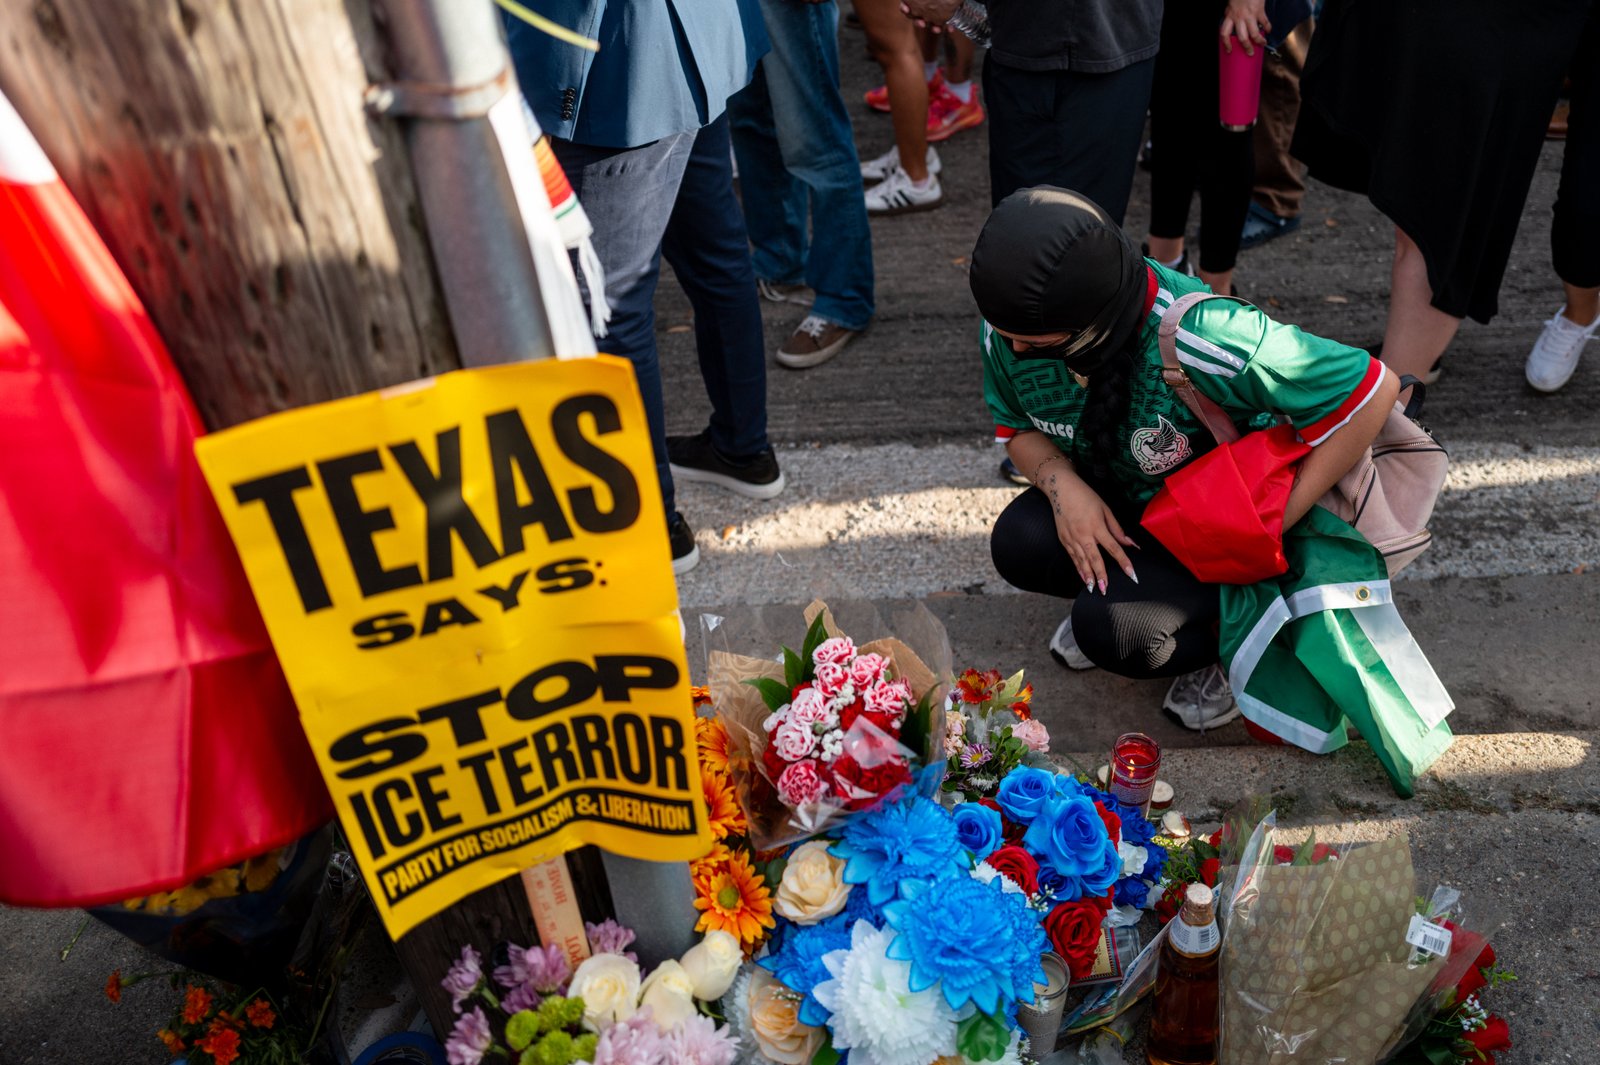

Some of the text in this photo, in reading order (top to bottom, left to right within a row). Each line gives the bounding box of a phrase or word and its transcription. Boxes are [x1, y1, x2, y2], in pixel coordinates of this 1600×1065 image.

[230, 393, 642, 616] TEXAS
[351, 556, 609, 650] SAYS:
[329, 655, 679, 780] STOP
[348, 712, 690, 861] ICE TERROR
[382, 793, 691, 899] PARTY FOR SOCIALISM & LIBERATION
